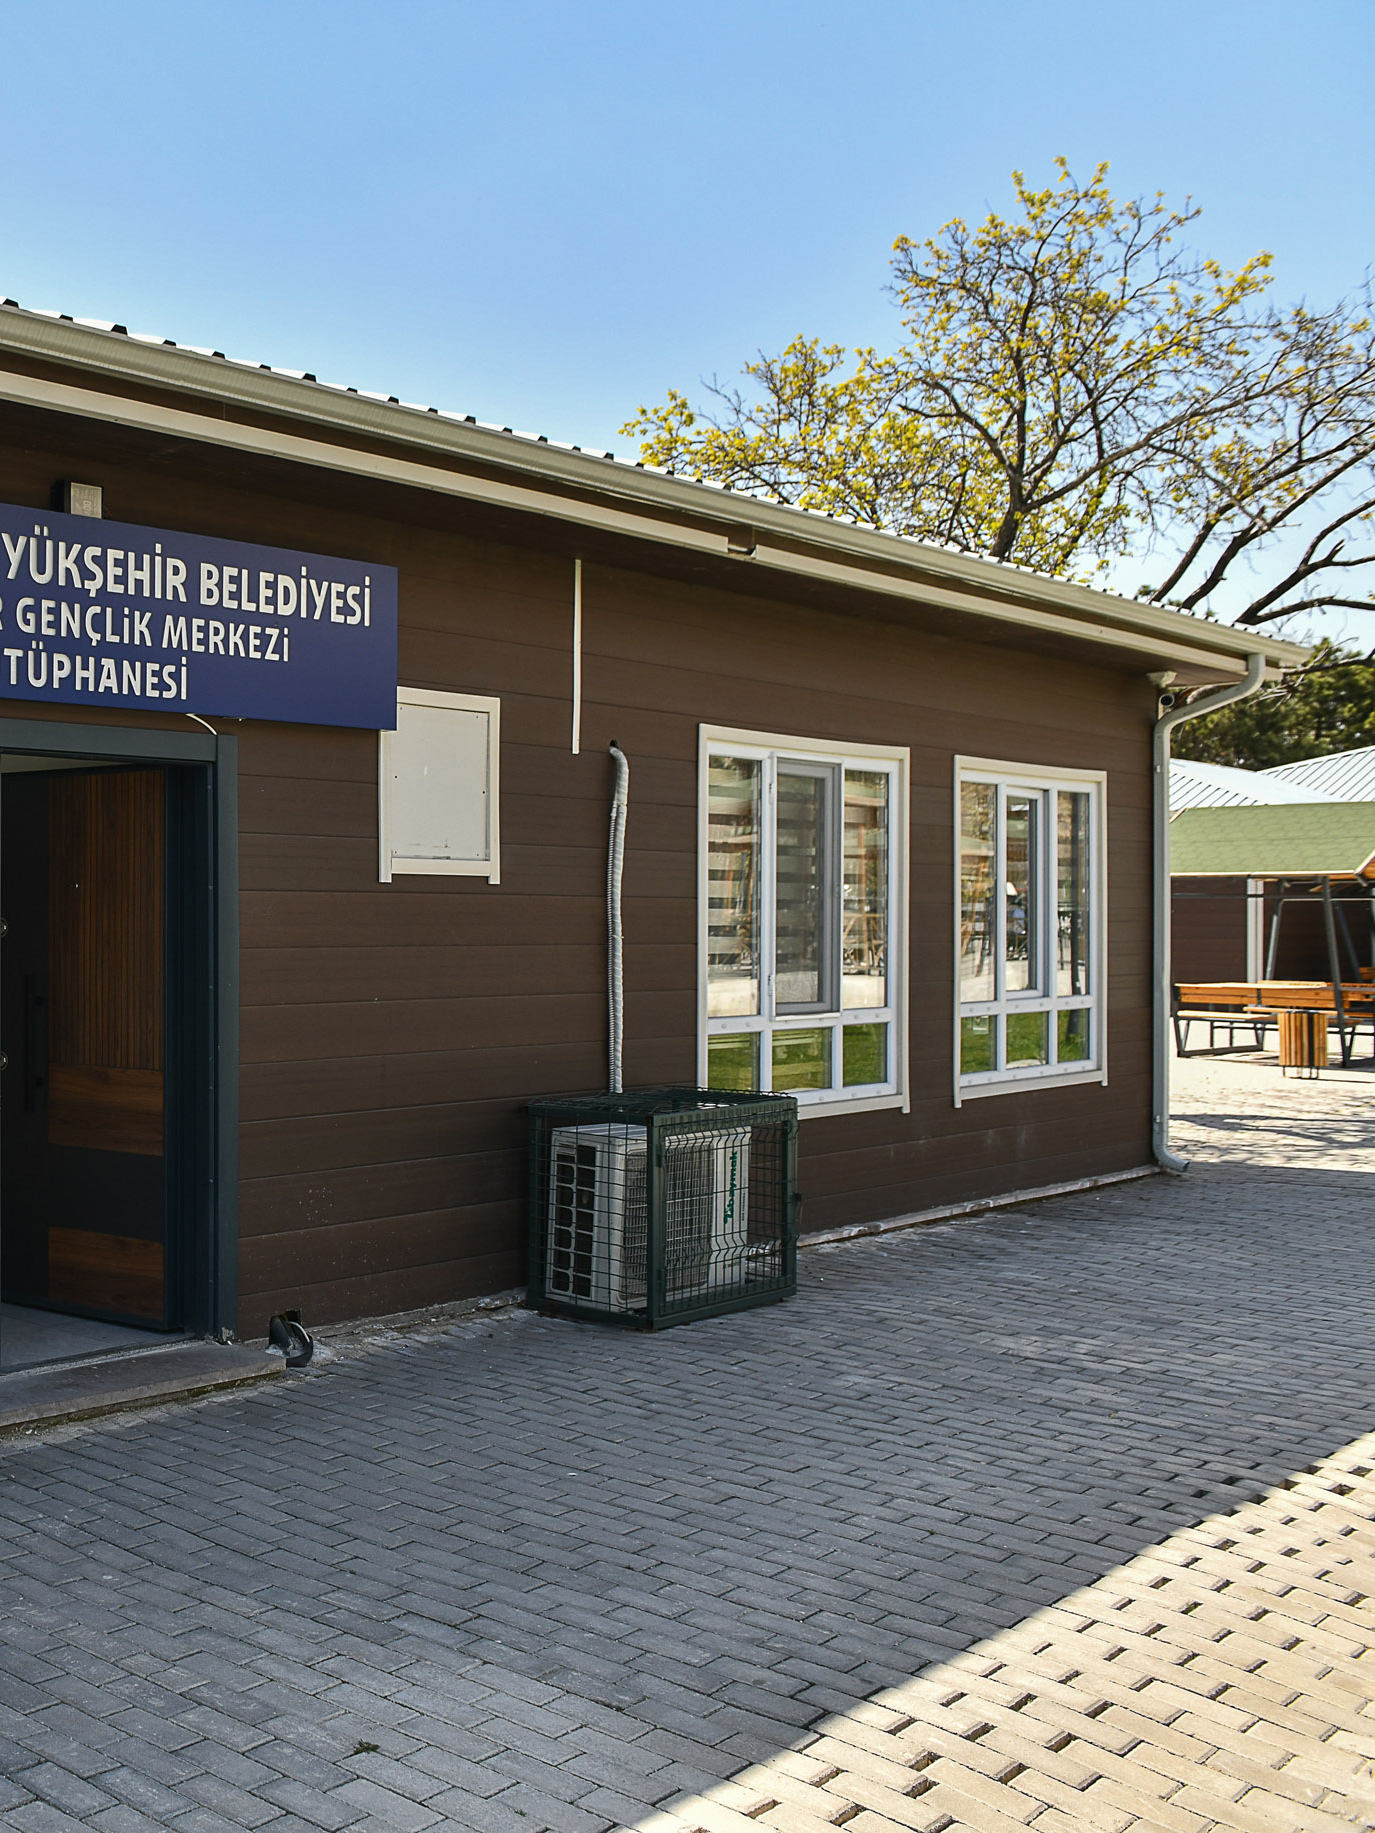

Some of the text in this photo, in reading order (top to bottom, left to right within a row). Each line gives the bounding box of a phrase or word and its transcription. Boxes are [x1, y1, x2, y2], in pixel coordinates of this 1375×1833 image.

[199, 565, 372, 627] BELEDİYESİ
[15, 596, 152, 647] GENÇLİK
[161, 614, 290, 662] MERKEZİ
